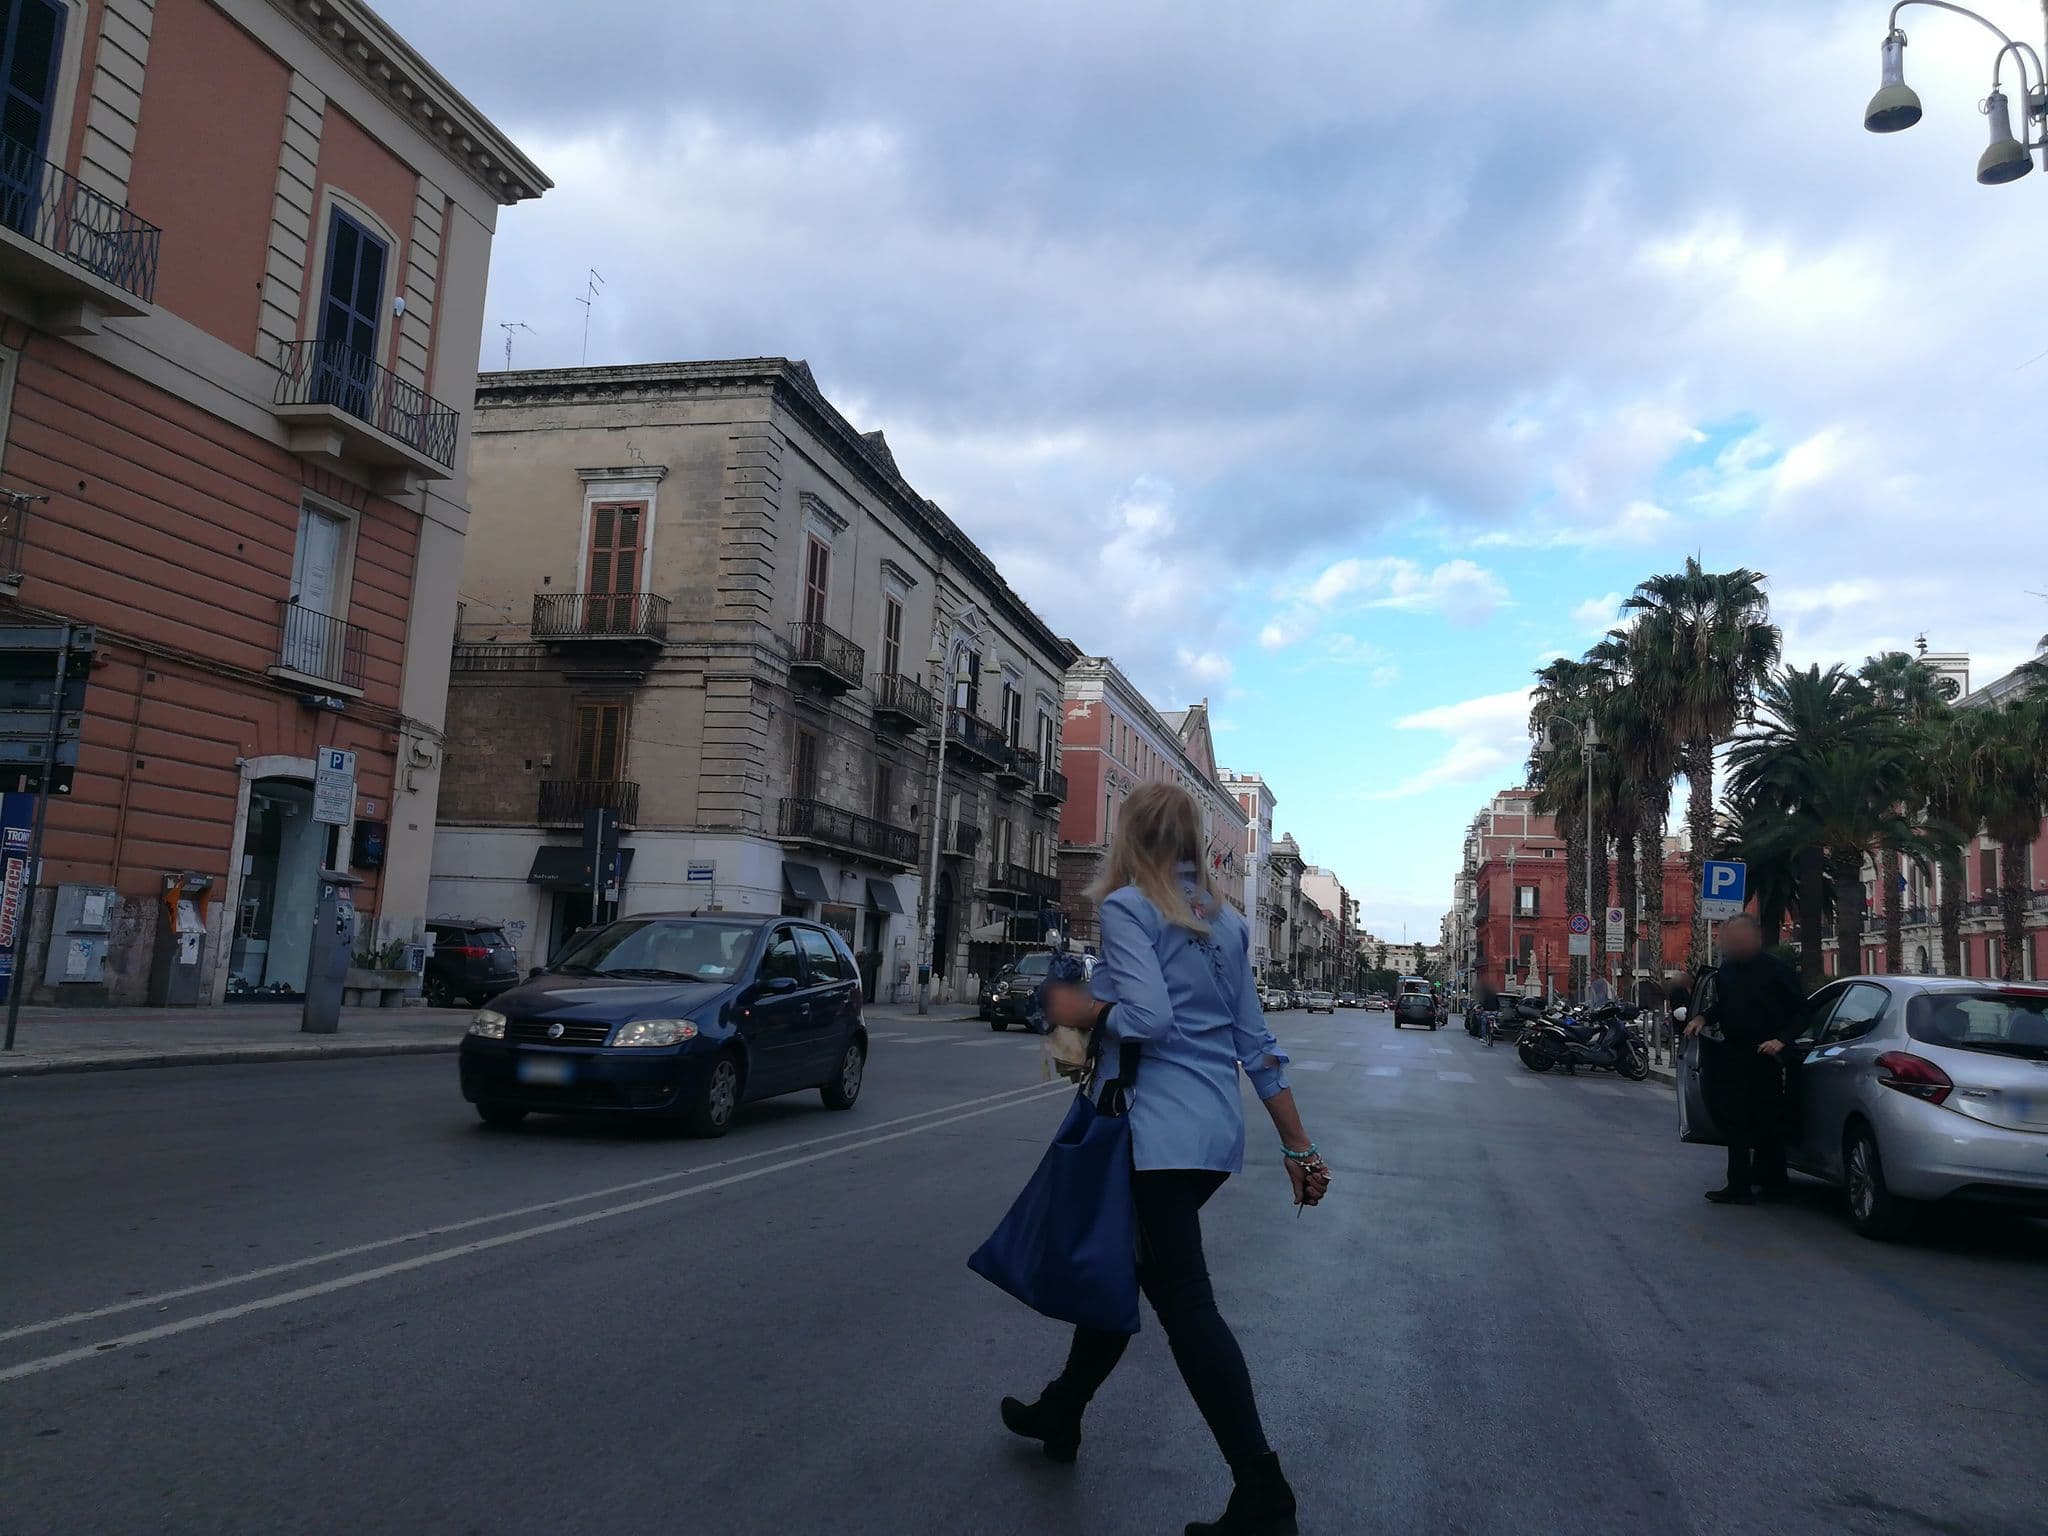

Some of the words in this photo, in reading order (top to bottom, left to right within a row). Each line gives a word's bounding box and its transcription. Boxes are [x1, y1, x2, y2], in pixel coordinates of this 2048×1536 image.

[333, 754, 342, 768] P
[1711, 866, 1737, 895] P
[325, 885, 333, 898] P
[0, 859, 22, 946] SUPERTECH
